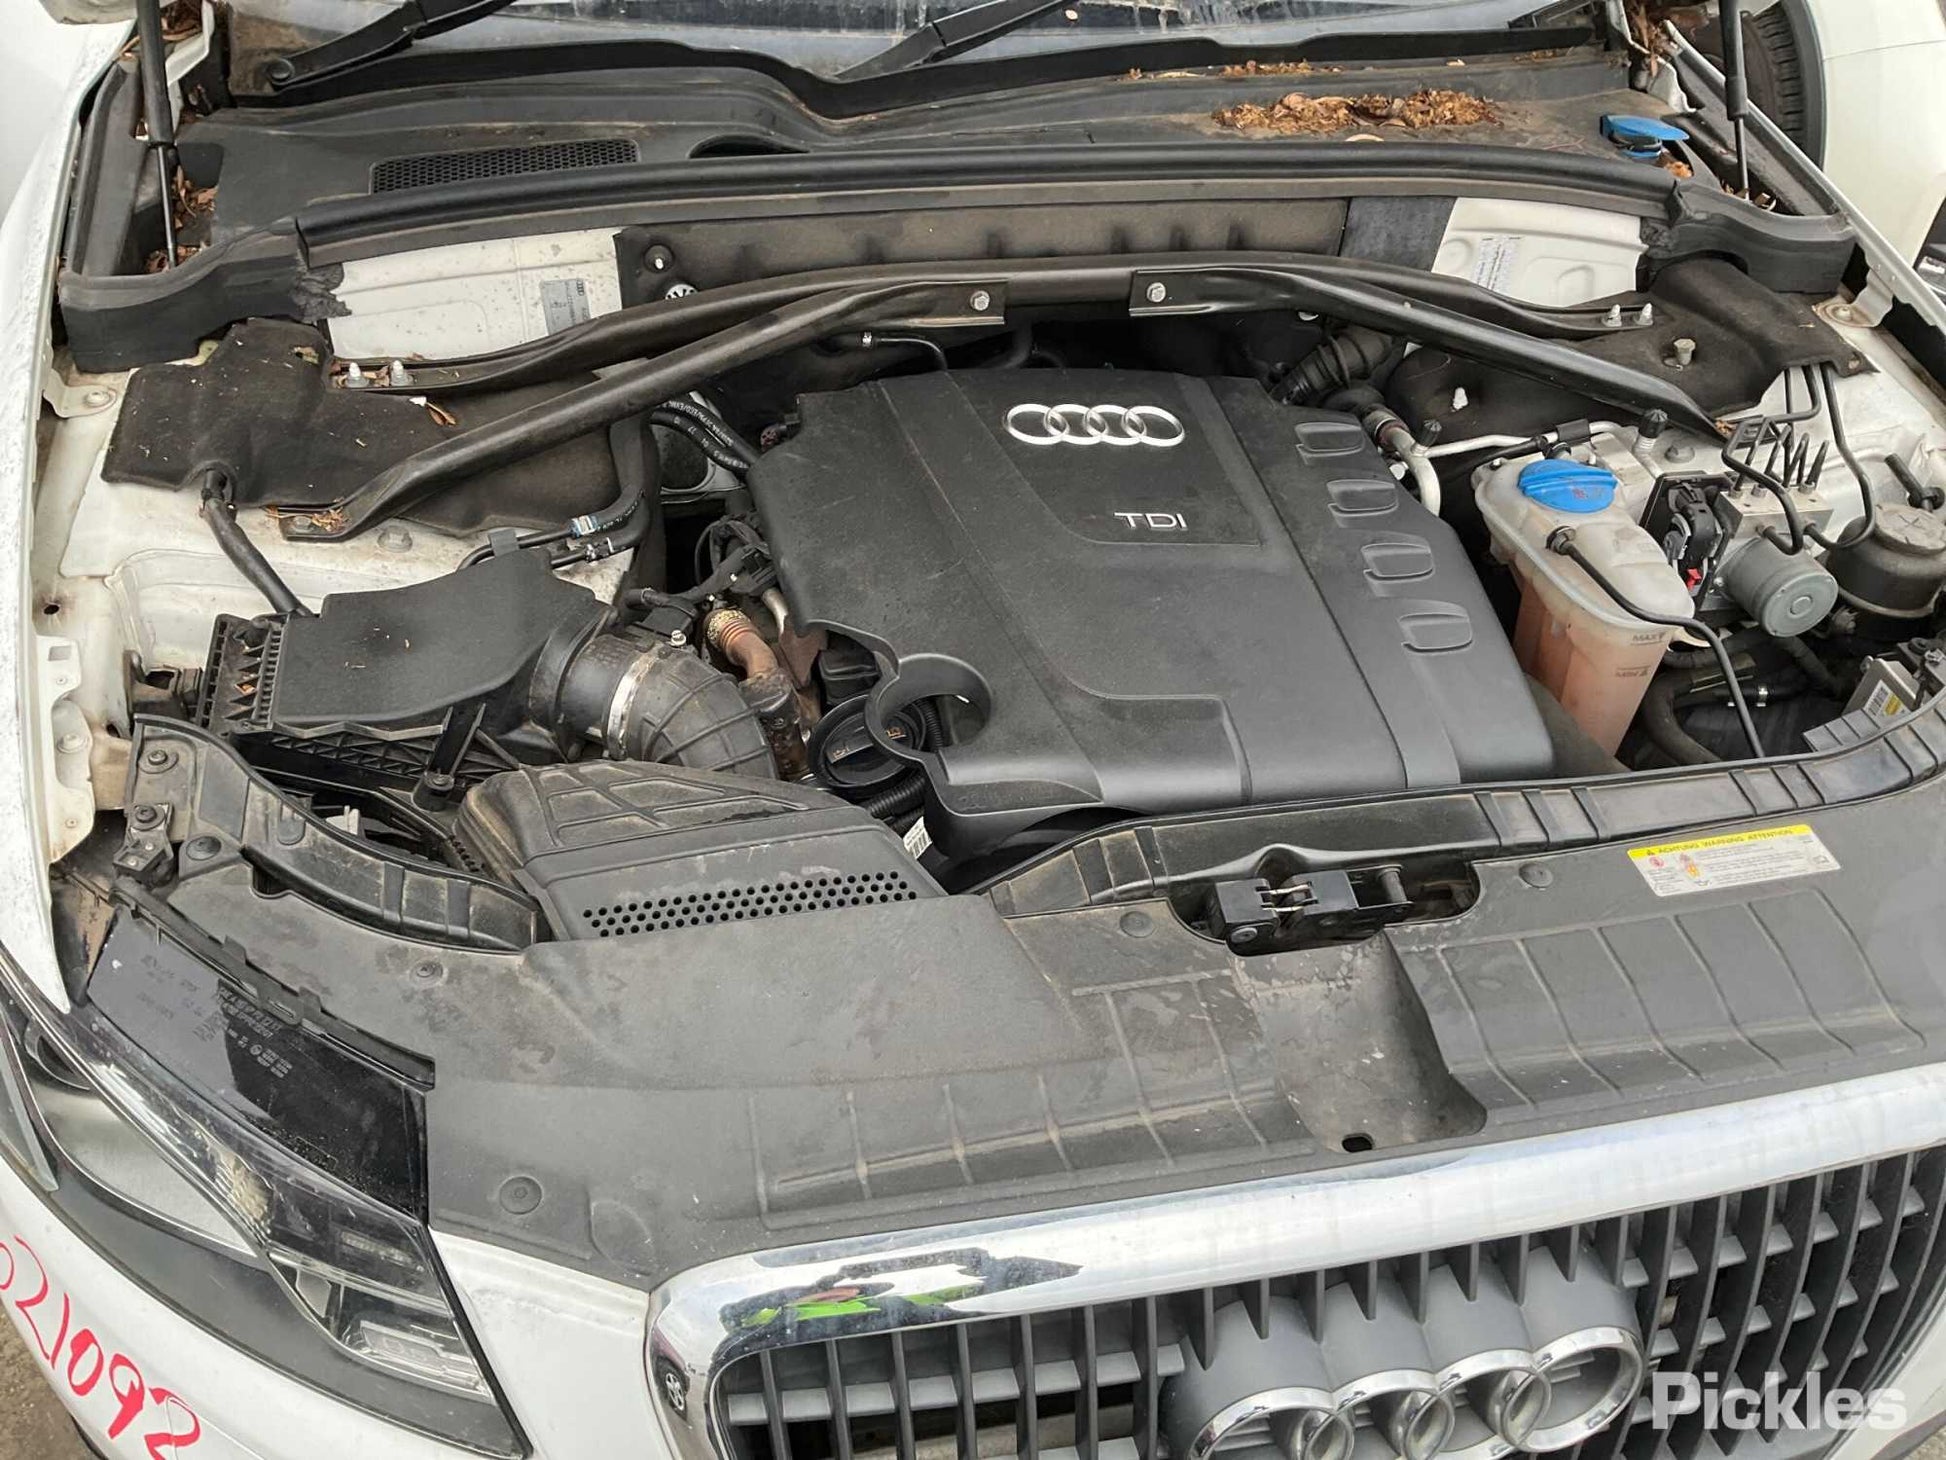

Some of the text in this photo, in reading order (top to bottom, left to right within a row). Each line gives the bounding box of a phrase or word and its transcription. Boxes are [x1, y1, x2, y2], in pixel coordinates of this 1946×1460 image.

[1114, 512, 1188, 530] TDI
[1658, 827, 1793, 855] ACHTUNG WARNING ATTENTION
